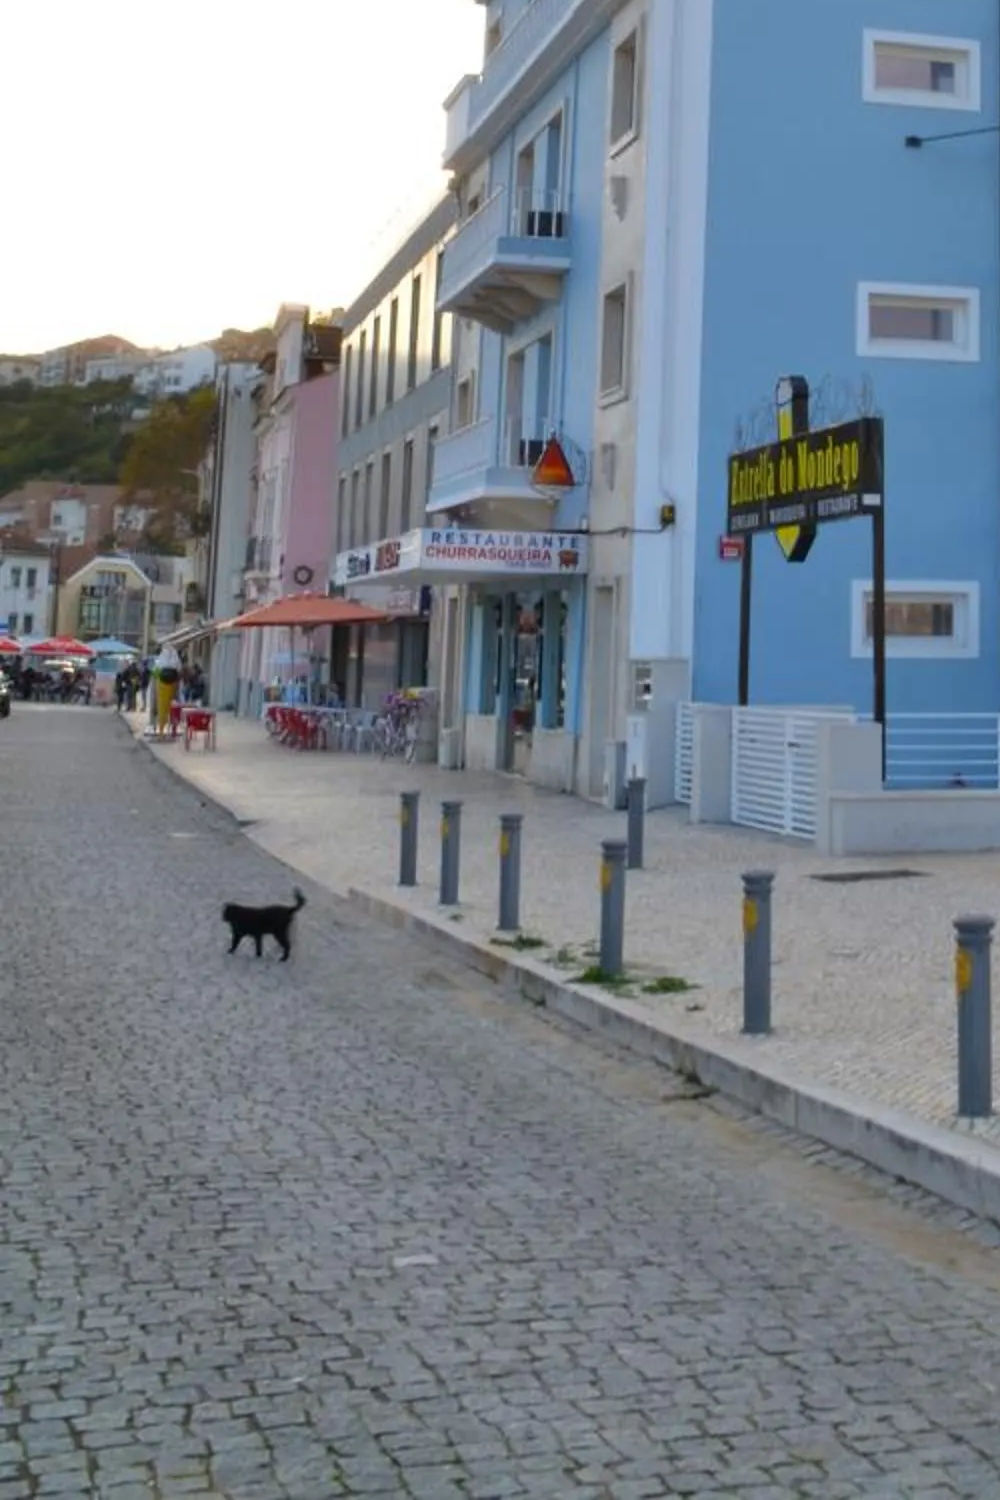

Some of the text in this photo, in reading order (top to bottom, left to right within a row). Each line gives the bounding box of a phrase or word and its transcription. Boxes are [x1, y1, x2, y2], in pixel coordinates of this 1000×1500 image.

[779, 445, 795, 495] do
[797, 435, 860, 491] Mondego
[431, 531, 578, 549] RESTAURANTE
[426, 545, 552, 561] CHURRASQUEIRA
